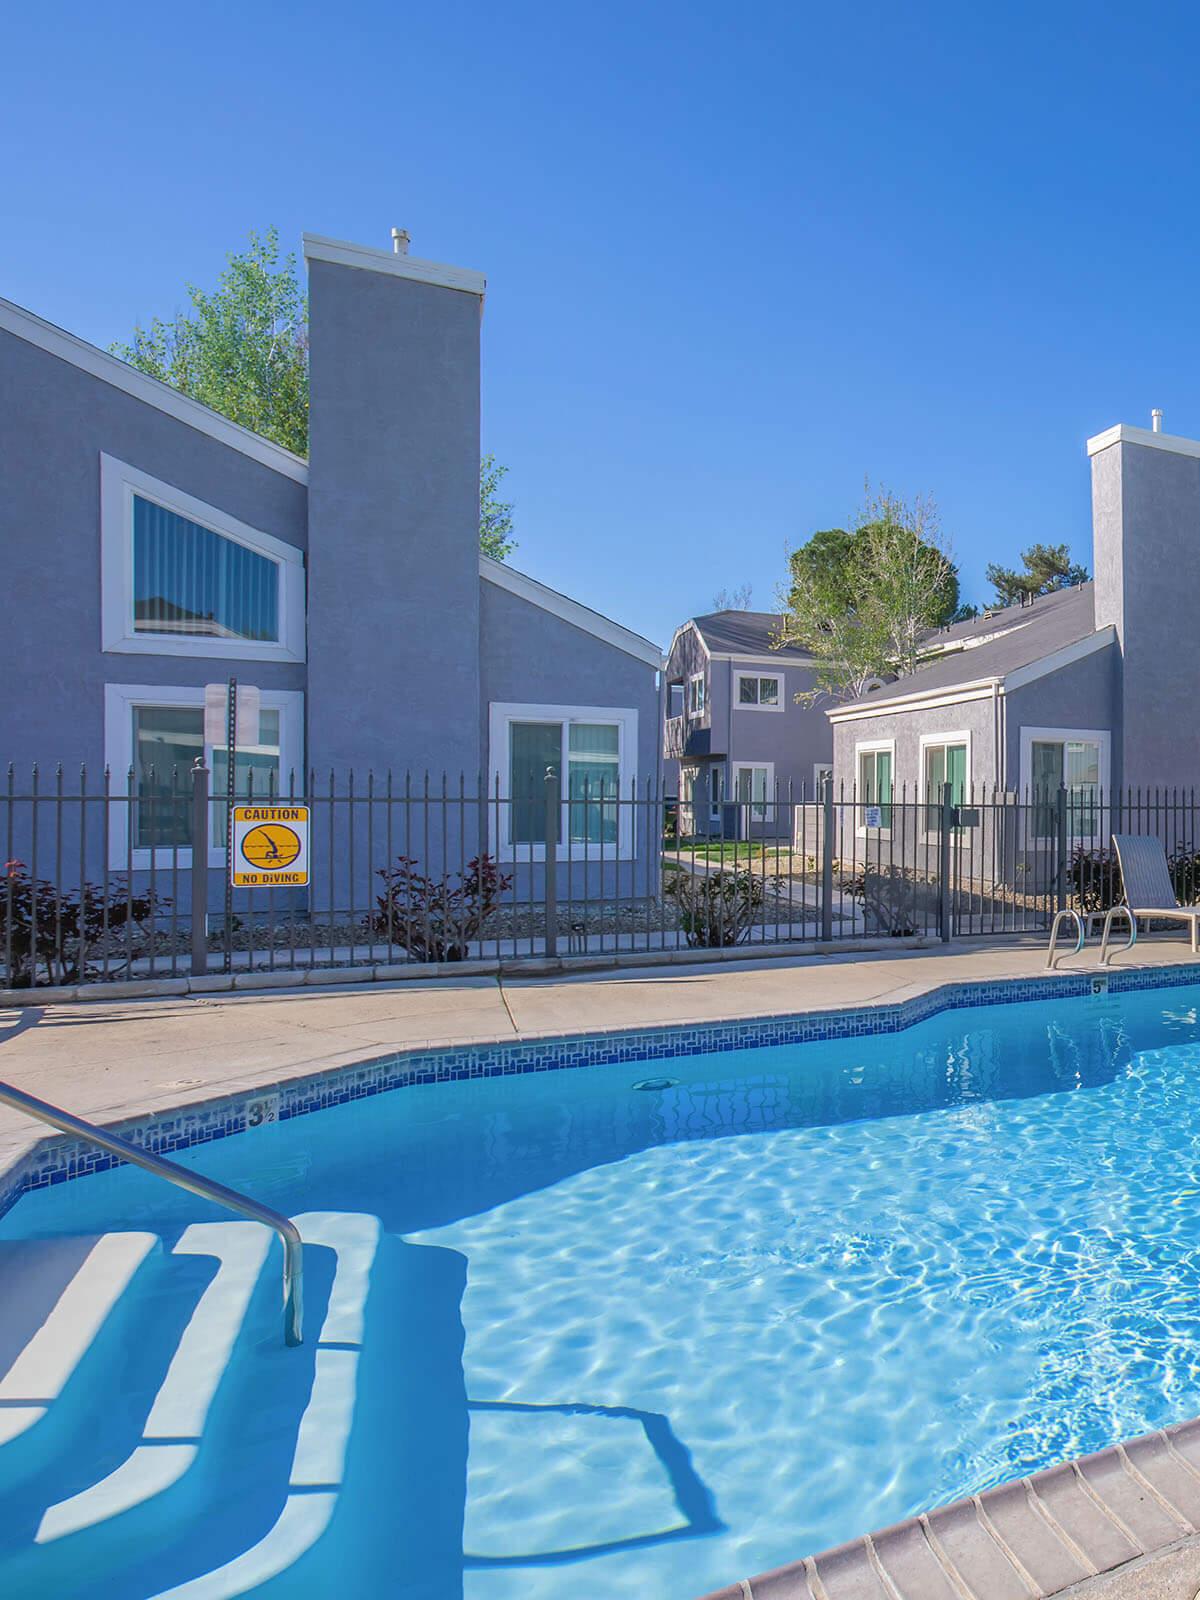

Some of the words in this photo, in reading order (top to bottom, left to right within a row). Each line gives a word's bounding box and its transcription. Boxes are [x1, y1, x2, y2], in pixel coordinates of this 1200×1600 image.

[244, 809, 299, 819] CAUTION
[242, 874, 258, 883] NO
[262, 873, 299, 883] DIVING
[1093, 979, 1101, 994] 5
